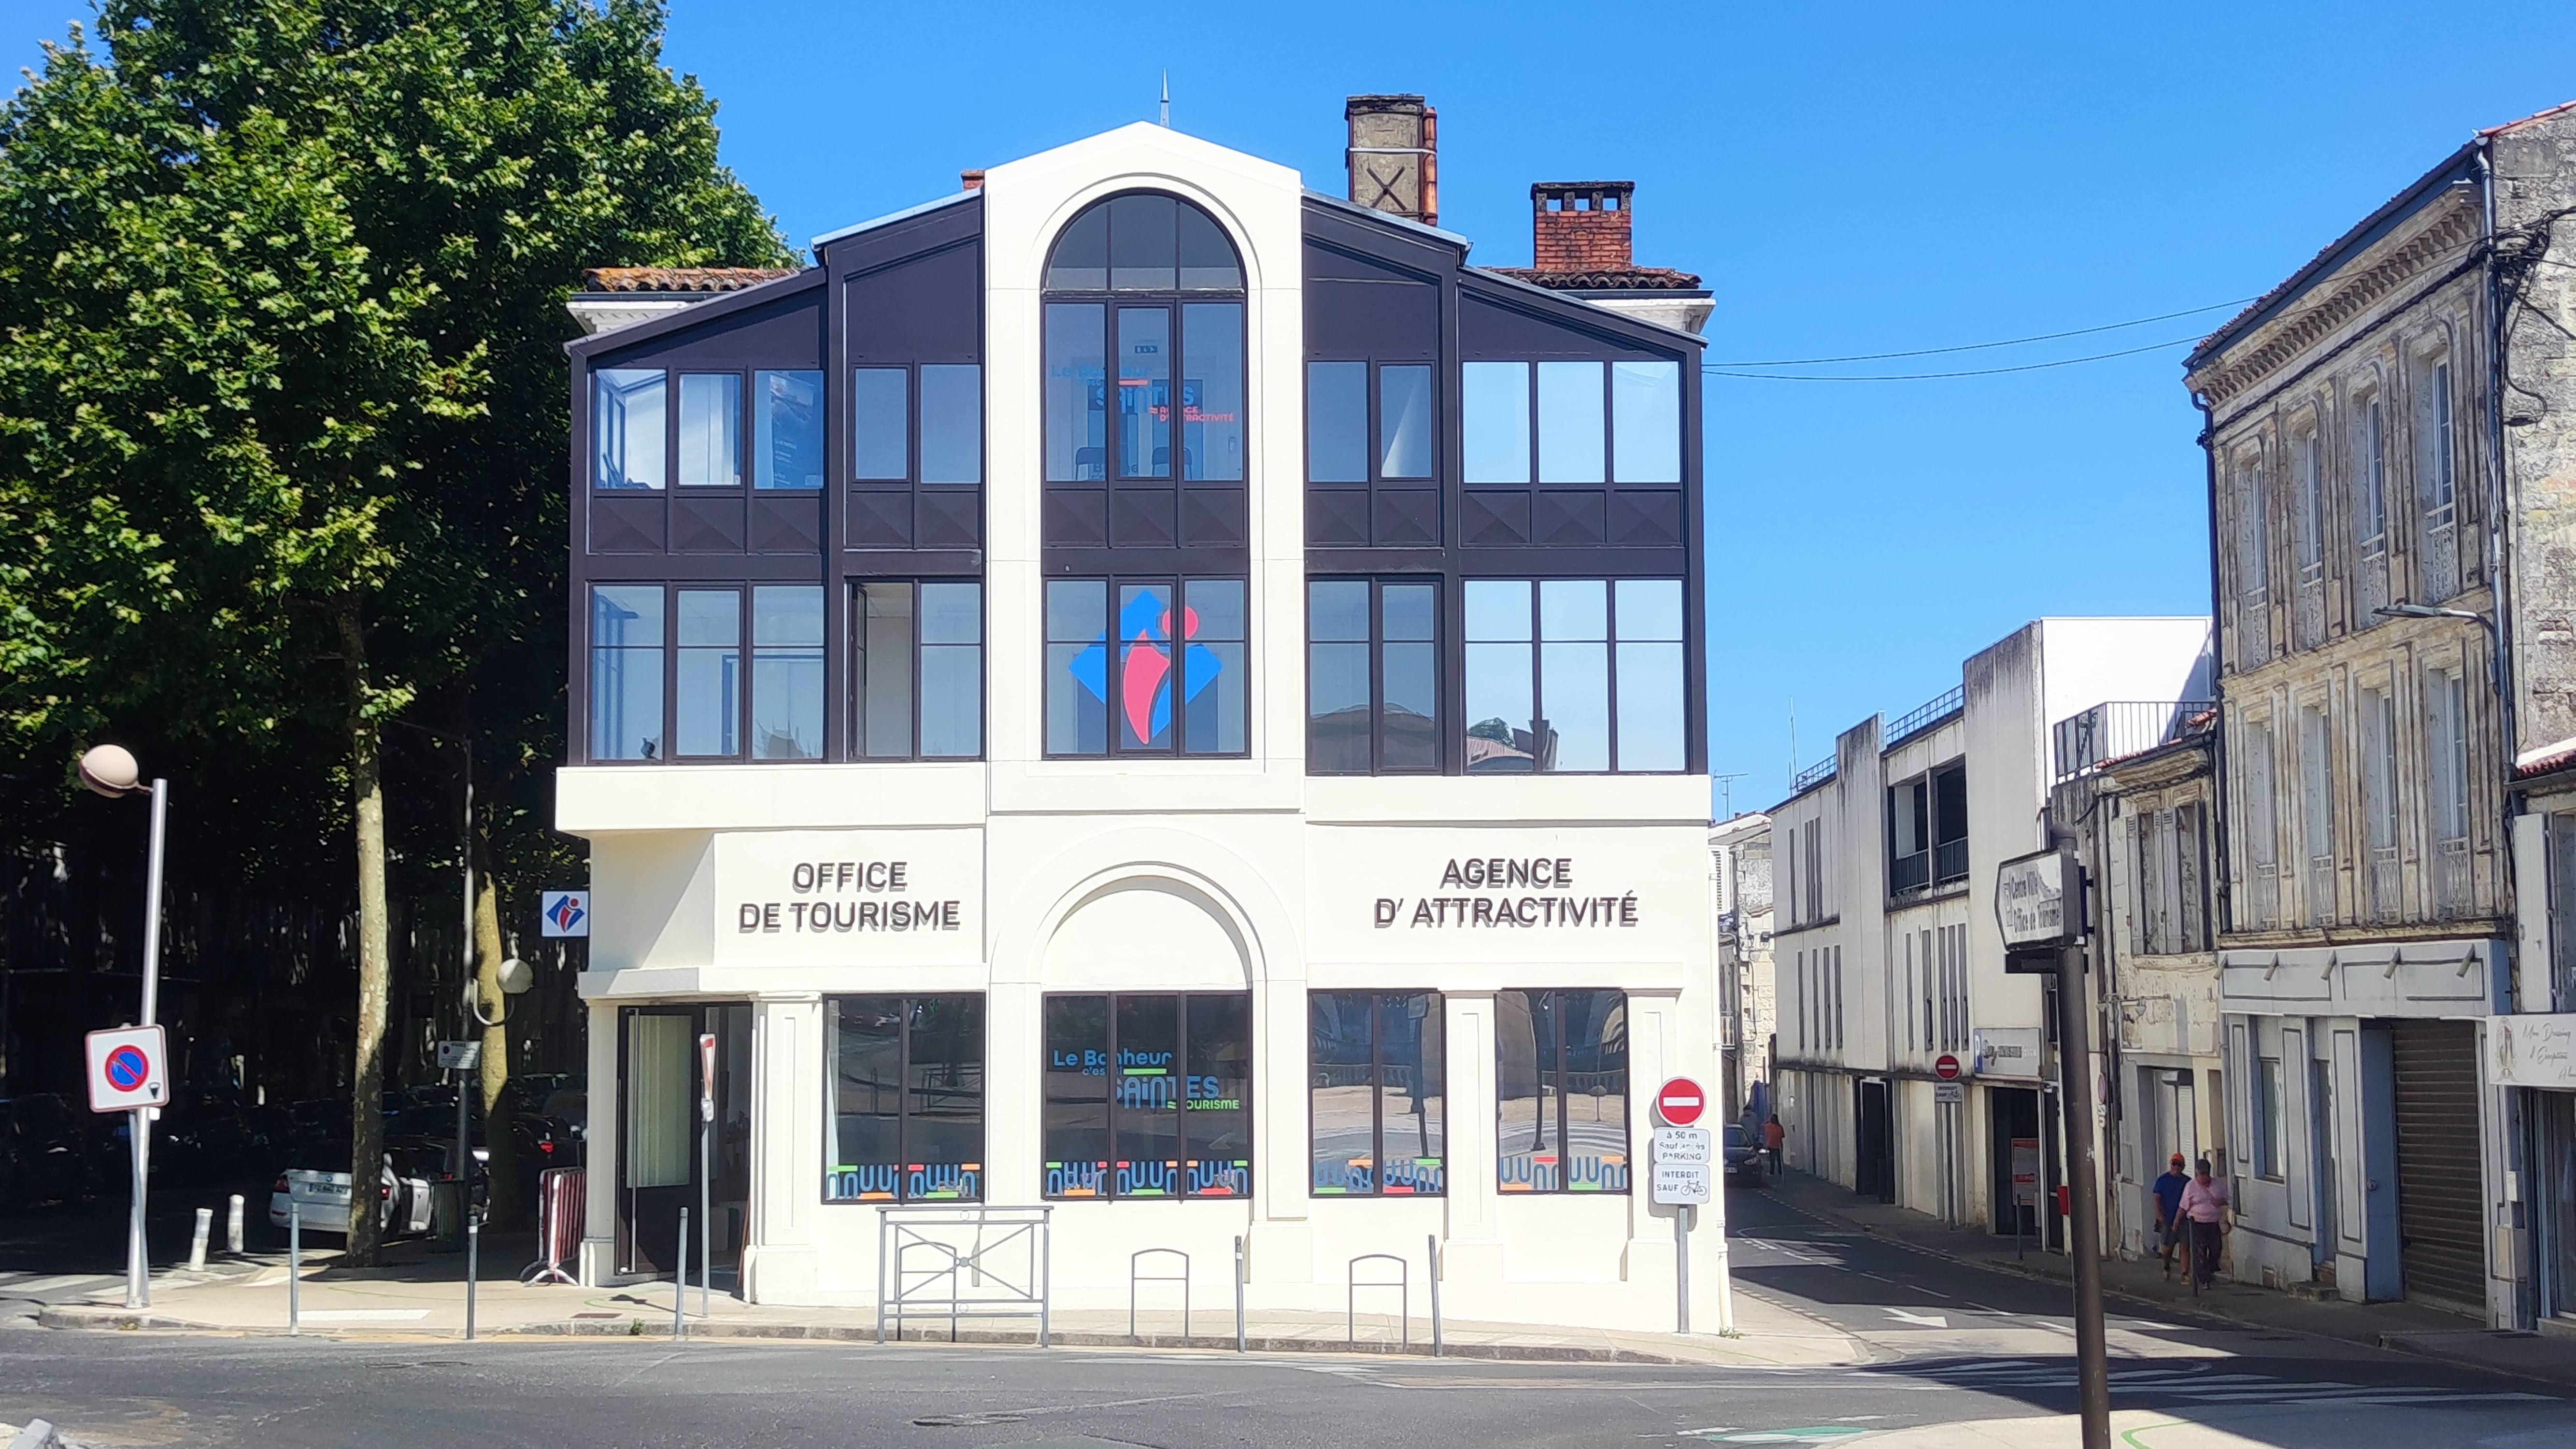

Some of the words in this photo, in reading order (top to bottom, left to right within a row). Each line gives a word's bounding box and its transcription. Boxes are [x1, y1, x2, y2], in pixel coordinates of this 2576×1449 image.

[793, 862, 908, 891] OFFICE
[1440, 858, 1573, 887] AGENCE
[740, 902, 782, 932] DE
[789, 900, 961, 931] TOURISME
[1411, 890, 1639, 927] ATTRACTIVITÉ
[2029, 906, 2036, 931] de
[1053, 1050, 1078, 1066] Le
[1975, 1035, 1980, 1068] P
[1082, 1066, 1106, 1076] c'es
[1186, 1099, 1240, 1110] OURISME
[1666, 1131, 1672, 1139] à
[1675, 1131, 1686, 1139] 50
